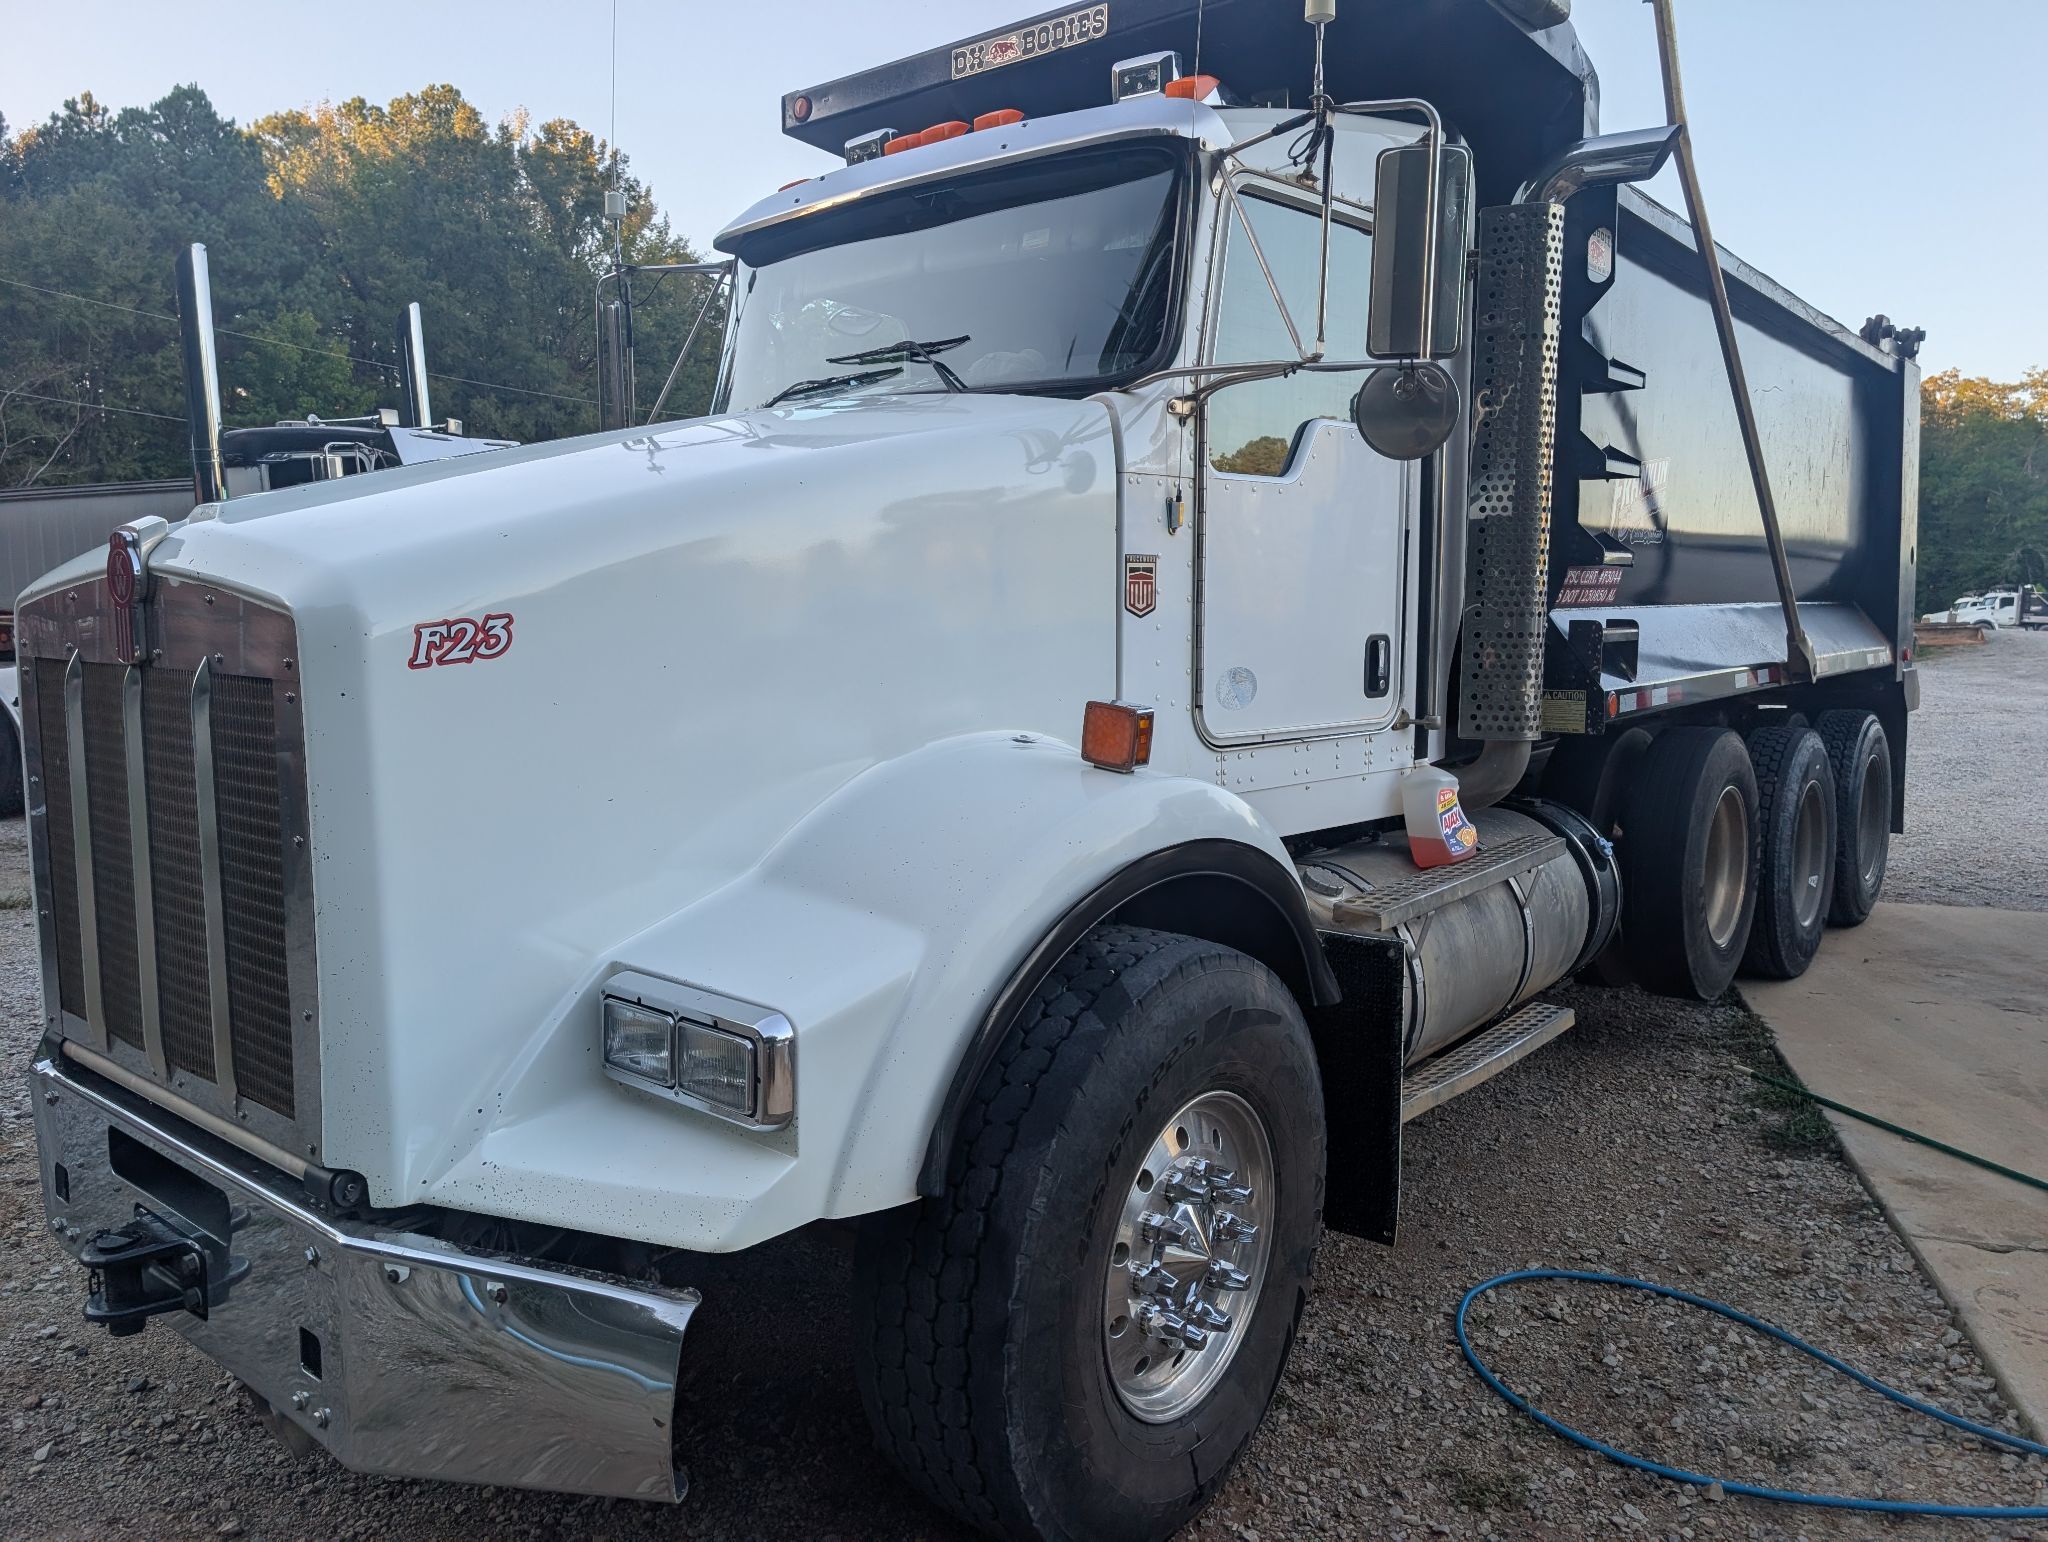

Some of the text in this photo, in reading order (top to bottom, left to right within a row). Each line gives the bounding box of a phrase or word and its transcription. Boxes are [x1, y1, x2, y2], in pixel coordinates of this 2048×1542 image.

[952, 7, 1106, 76] OX BODIES
[1562, 589, 1580, 602] DOT
[408, 613, 514, 670] F23
[1553, 691, 1585, 700] CAUTION
[1442, 806, 1462, 834] AJAX
